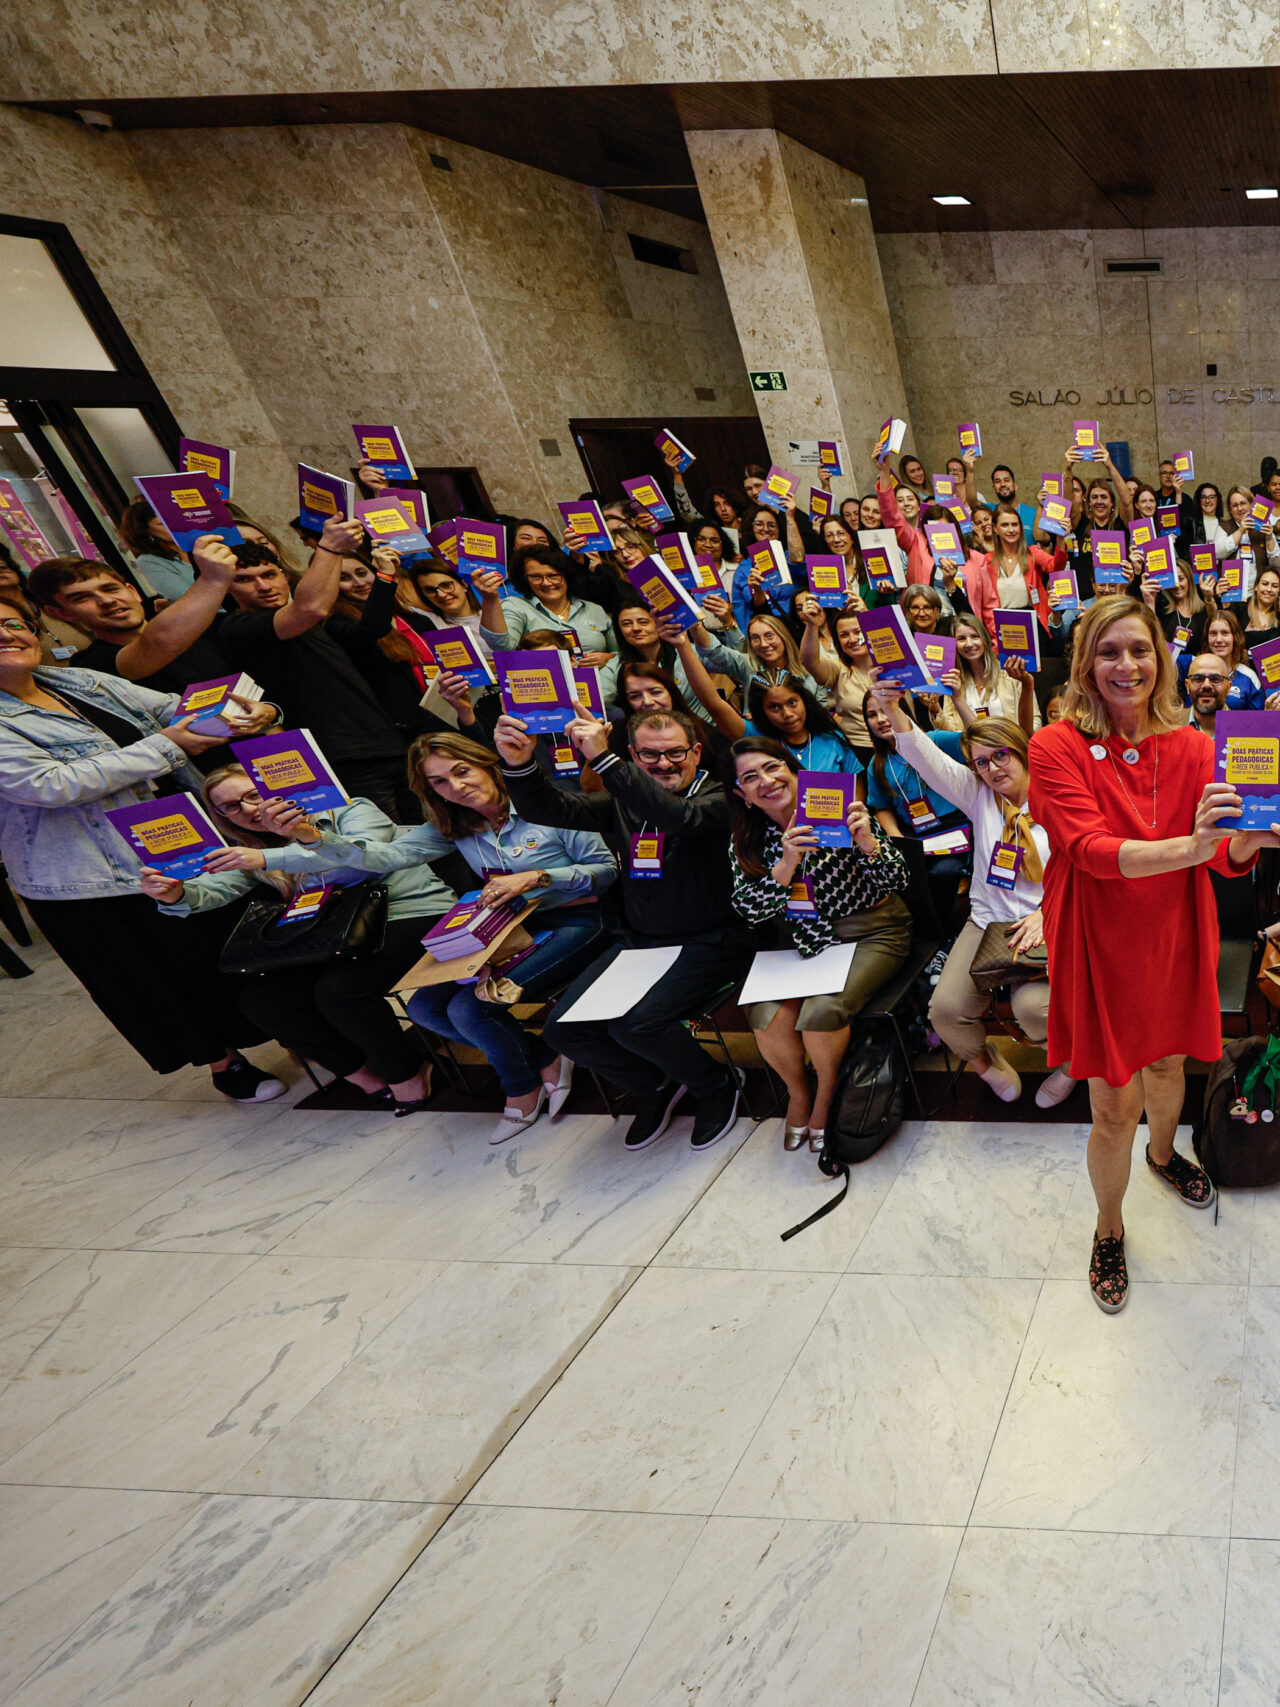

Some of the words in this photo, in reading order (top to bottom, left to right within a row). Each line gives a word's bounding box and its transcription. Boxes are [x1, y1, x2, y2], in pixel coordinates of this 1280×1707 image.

[1096, 386, 1153, 406] JÚLIO
[1168, 387, 1196, 404] DE
[1248, 746, 1274, 754] PRÁTICAS
[275, 758, 299, 766] PRÁTICAS
[1232, 754, 1273, 763] PEDAGÓGICAS
